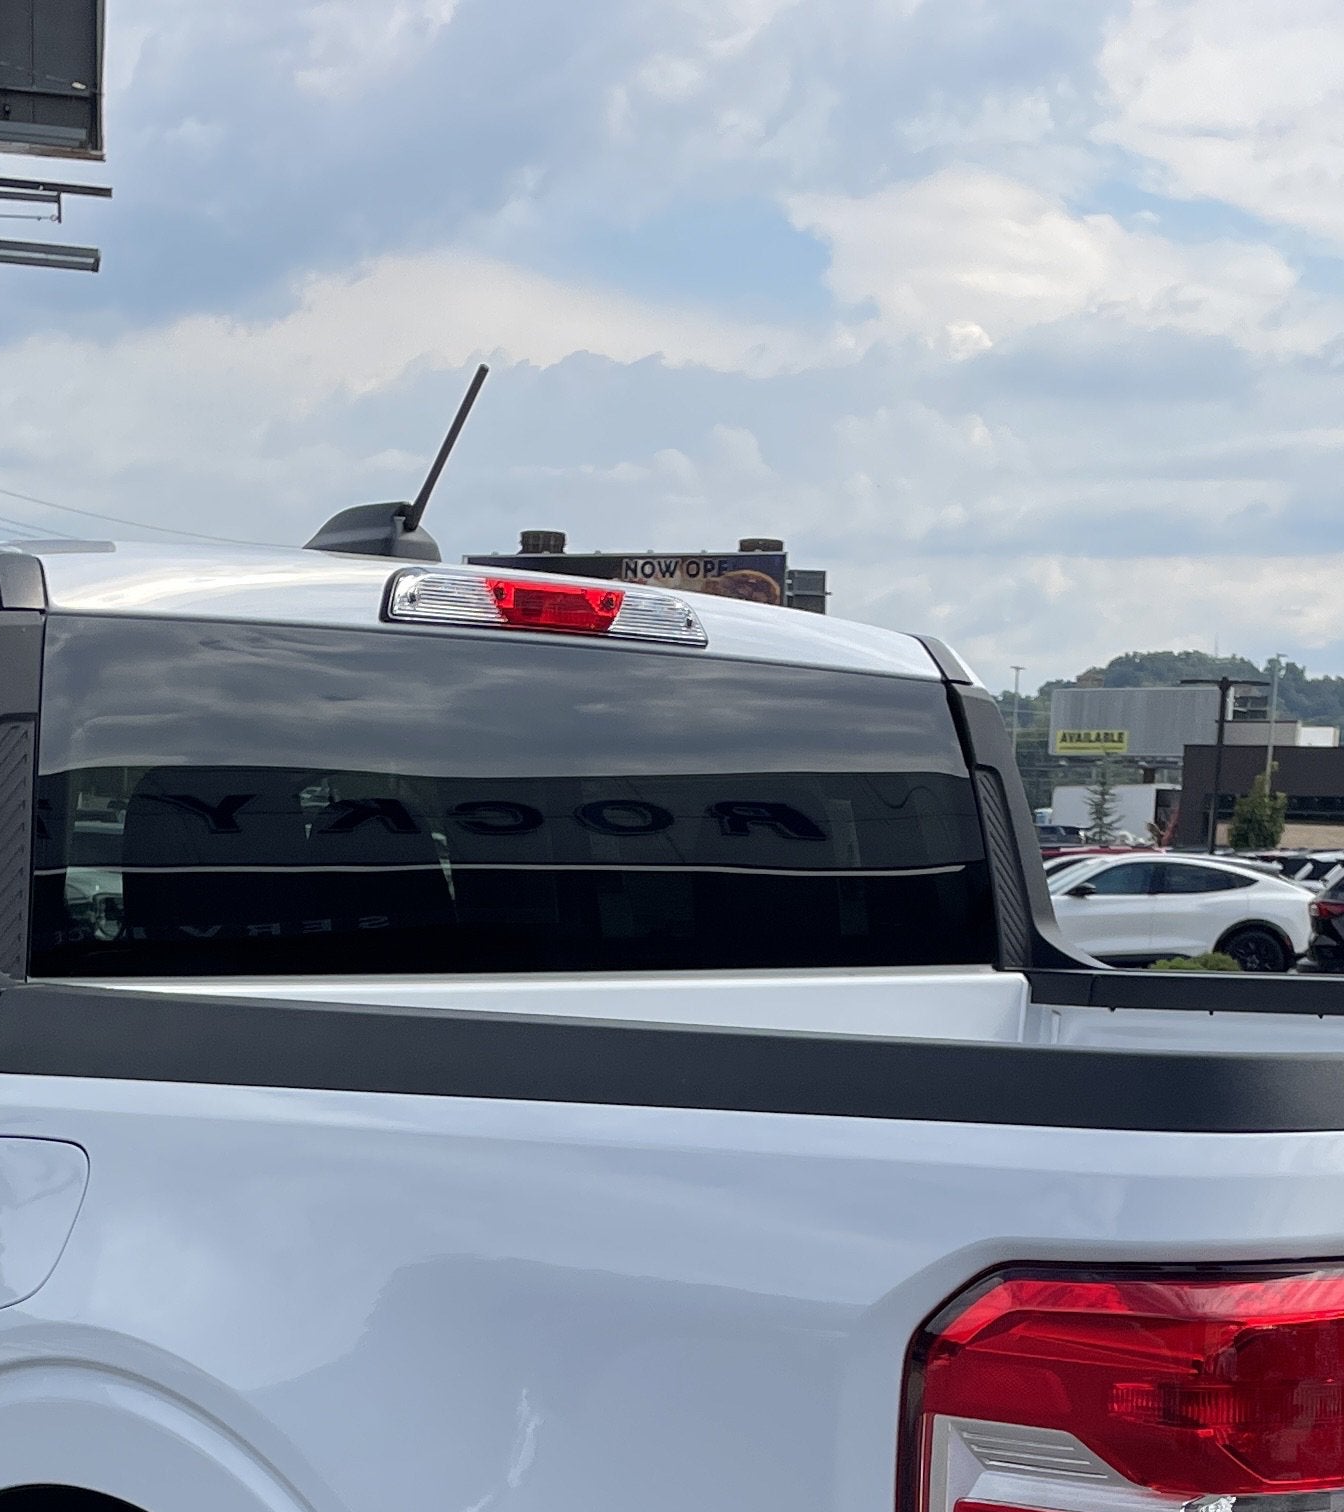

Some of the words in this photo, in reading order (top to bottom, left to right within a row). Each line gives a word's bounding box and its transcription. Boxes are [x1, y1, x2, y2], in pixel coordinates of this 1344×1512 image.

[623, 560, 678, 579] NOW
[685, 560, 730, 579] OPE
[1058, 731, 1125, 744] AVAILABLE
